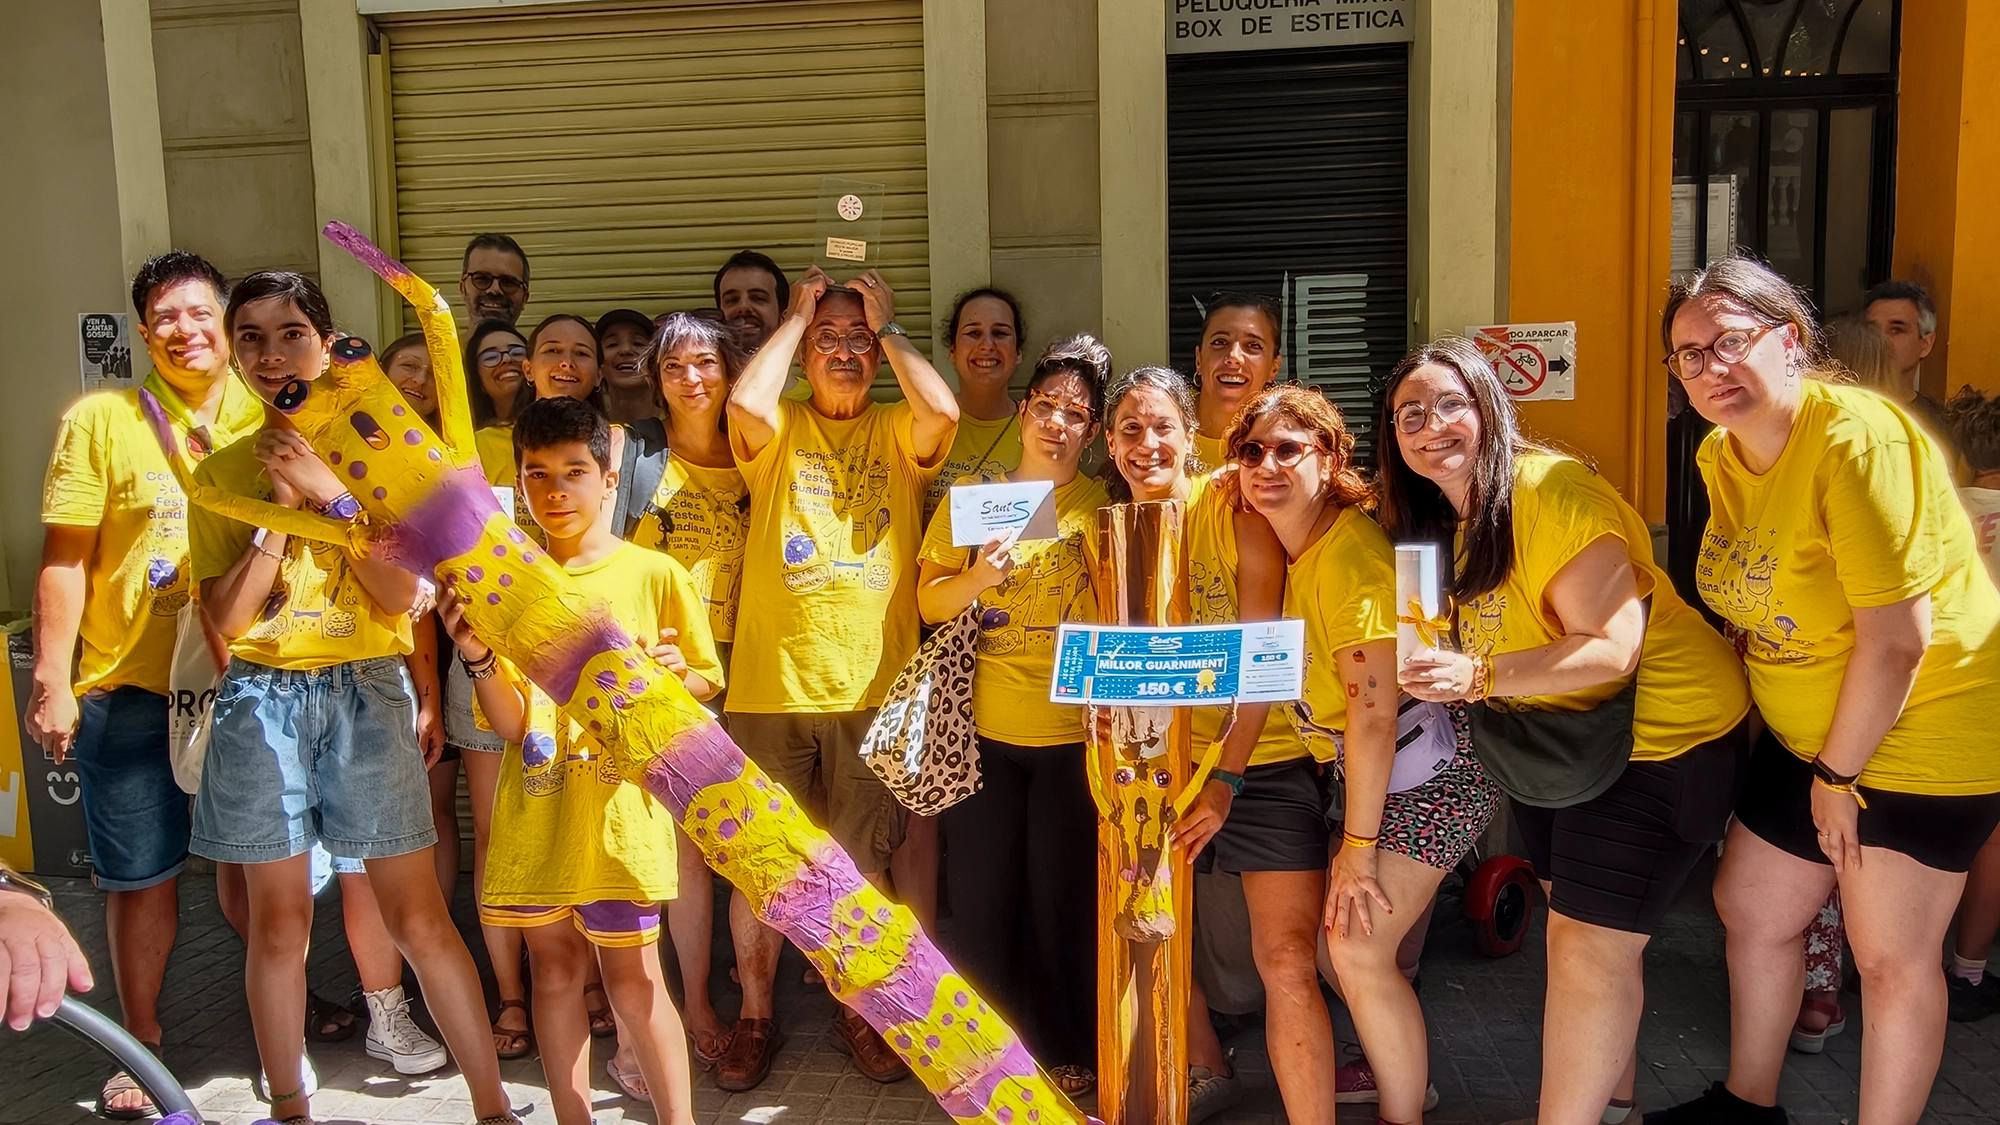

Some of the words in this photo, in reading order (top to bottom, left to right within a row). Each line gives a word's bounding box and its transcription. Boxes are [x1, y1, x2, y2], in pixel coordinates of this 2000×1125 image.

[1176, 19, 1222, 38] BOX
[1241, 16, 1272, 35] DE
[1291, 9, 1405, 32] ESTETICA
[86, 324, 113, 332] CANTAR
[1525, 329, 1568, 338] APARCAR
[86, 331, 115, 339] GOSPEL
[813, 461, 828, 473] de
[799, 470, 839, 486] Festes
[789, 481, 846, 500] Guadiana
[156, 496, 185, 507] Fest
[680, 499, 694, 510] de
[147, 508, 186, 520] Guadi
[668, 509, 705, 522] Festes
[1099, 659, 1143, 671] MILLOR
[1145, 658, 1225, 671] GUARNIMENT
[1136, 682, 1170, 696] 150
[1172, 681, 1186, 695] €
